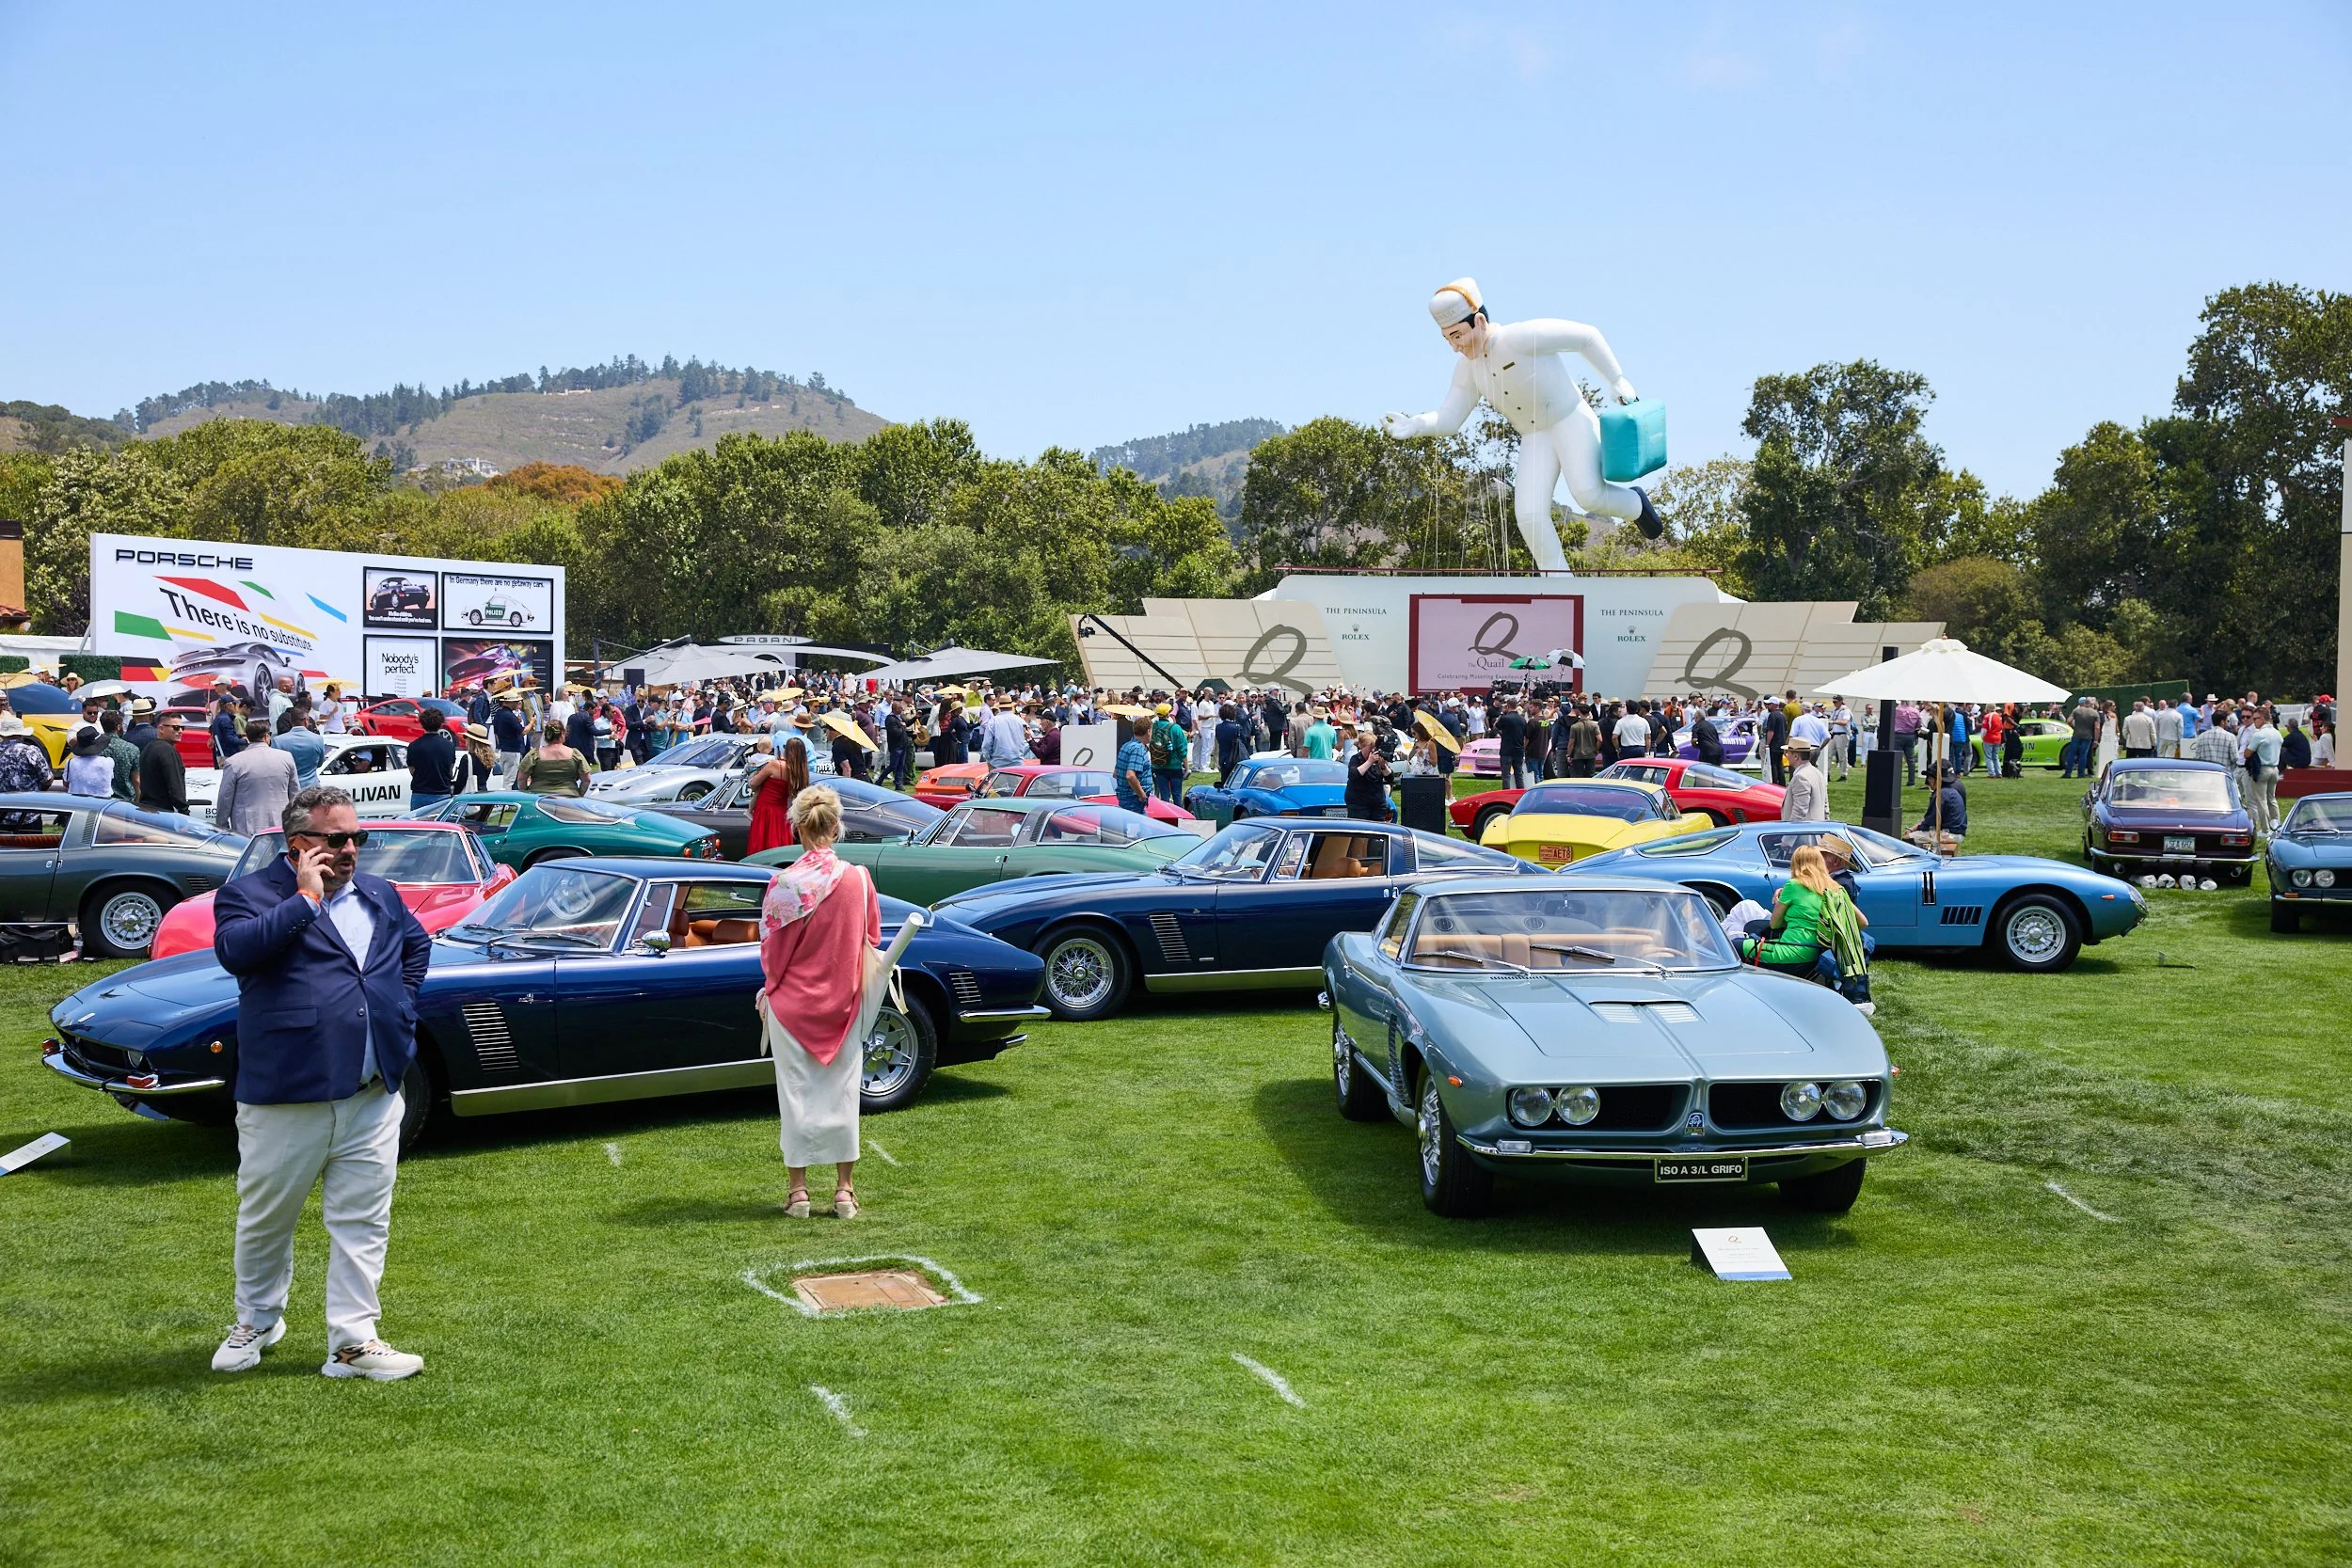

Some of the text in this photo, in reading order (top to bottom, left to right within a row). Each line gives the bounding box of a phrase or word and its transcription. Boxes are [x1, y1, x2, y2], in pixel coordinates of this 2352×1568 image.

[116, 548, 253, 570] PORSCHE
[456, 576, 479, 587] Germany
[480, 578, 493, 586] there
[512, 579, 532, 589] getaway
[159, 587, 314, 652] There is no substitute.
[1468, 611, 1522, 661] Q
[381, 653, 420, 666] Nobody's
[1233, 624, 1314, 696] Q
[1476, 657, 1504, 671] Quail
[1675, 627, 1759, 702] Q
[385, 663, 417, 675] perfect.
[353, 784, 401, 802] LIVAN
[1660, 1164, 1742, 1175] ISO A 3/L GRIFO
